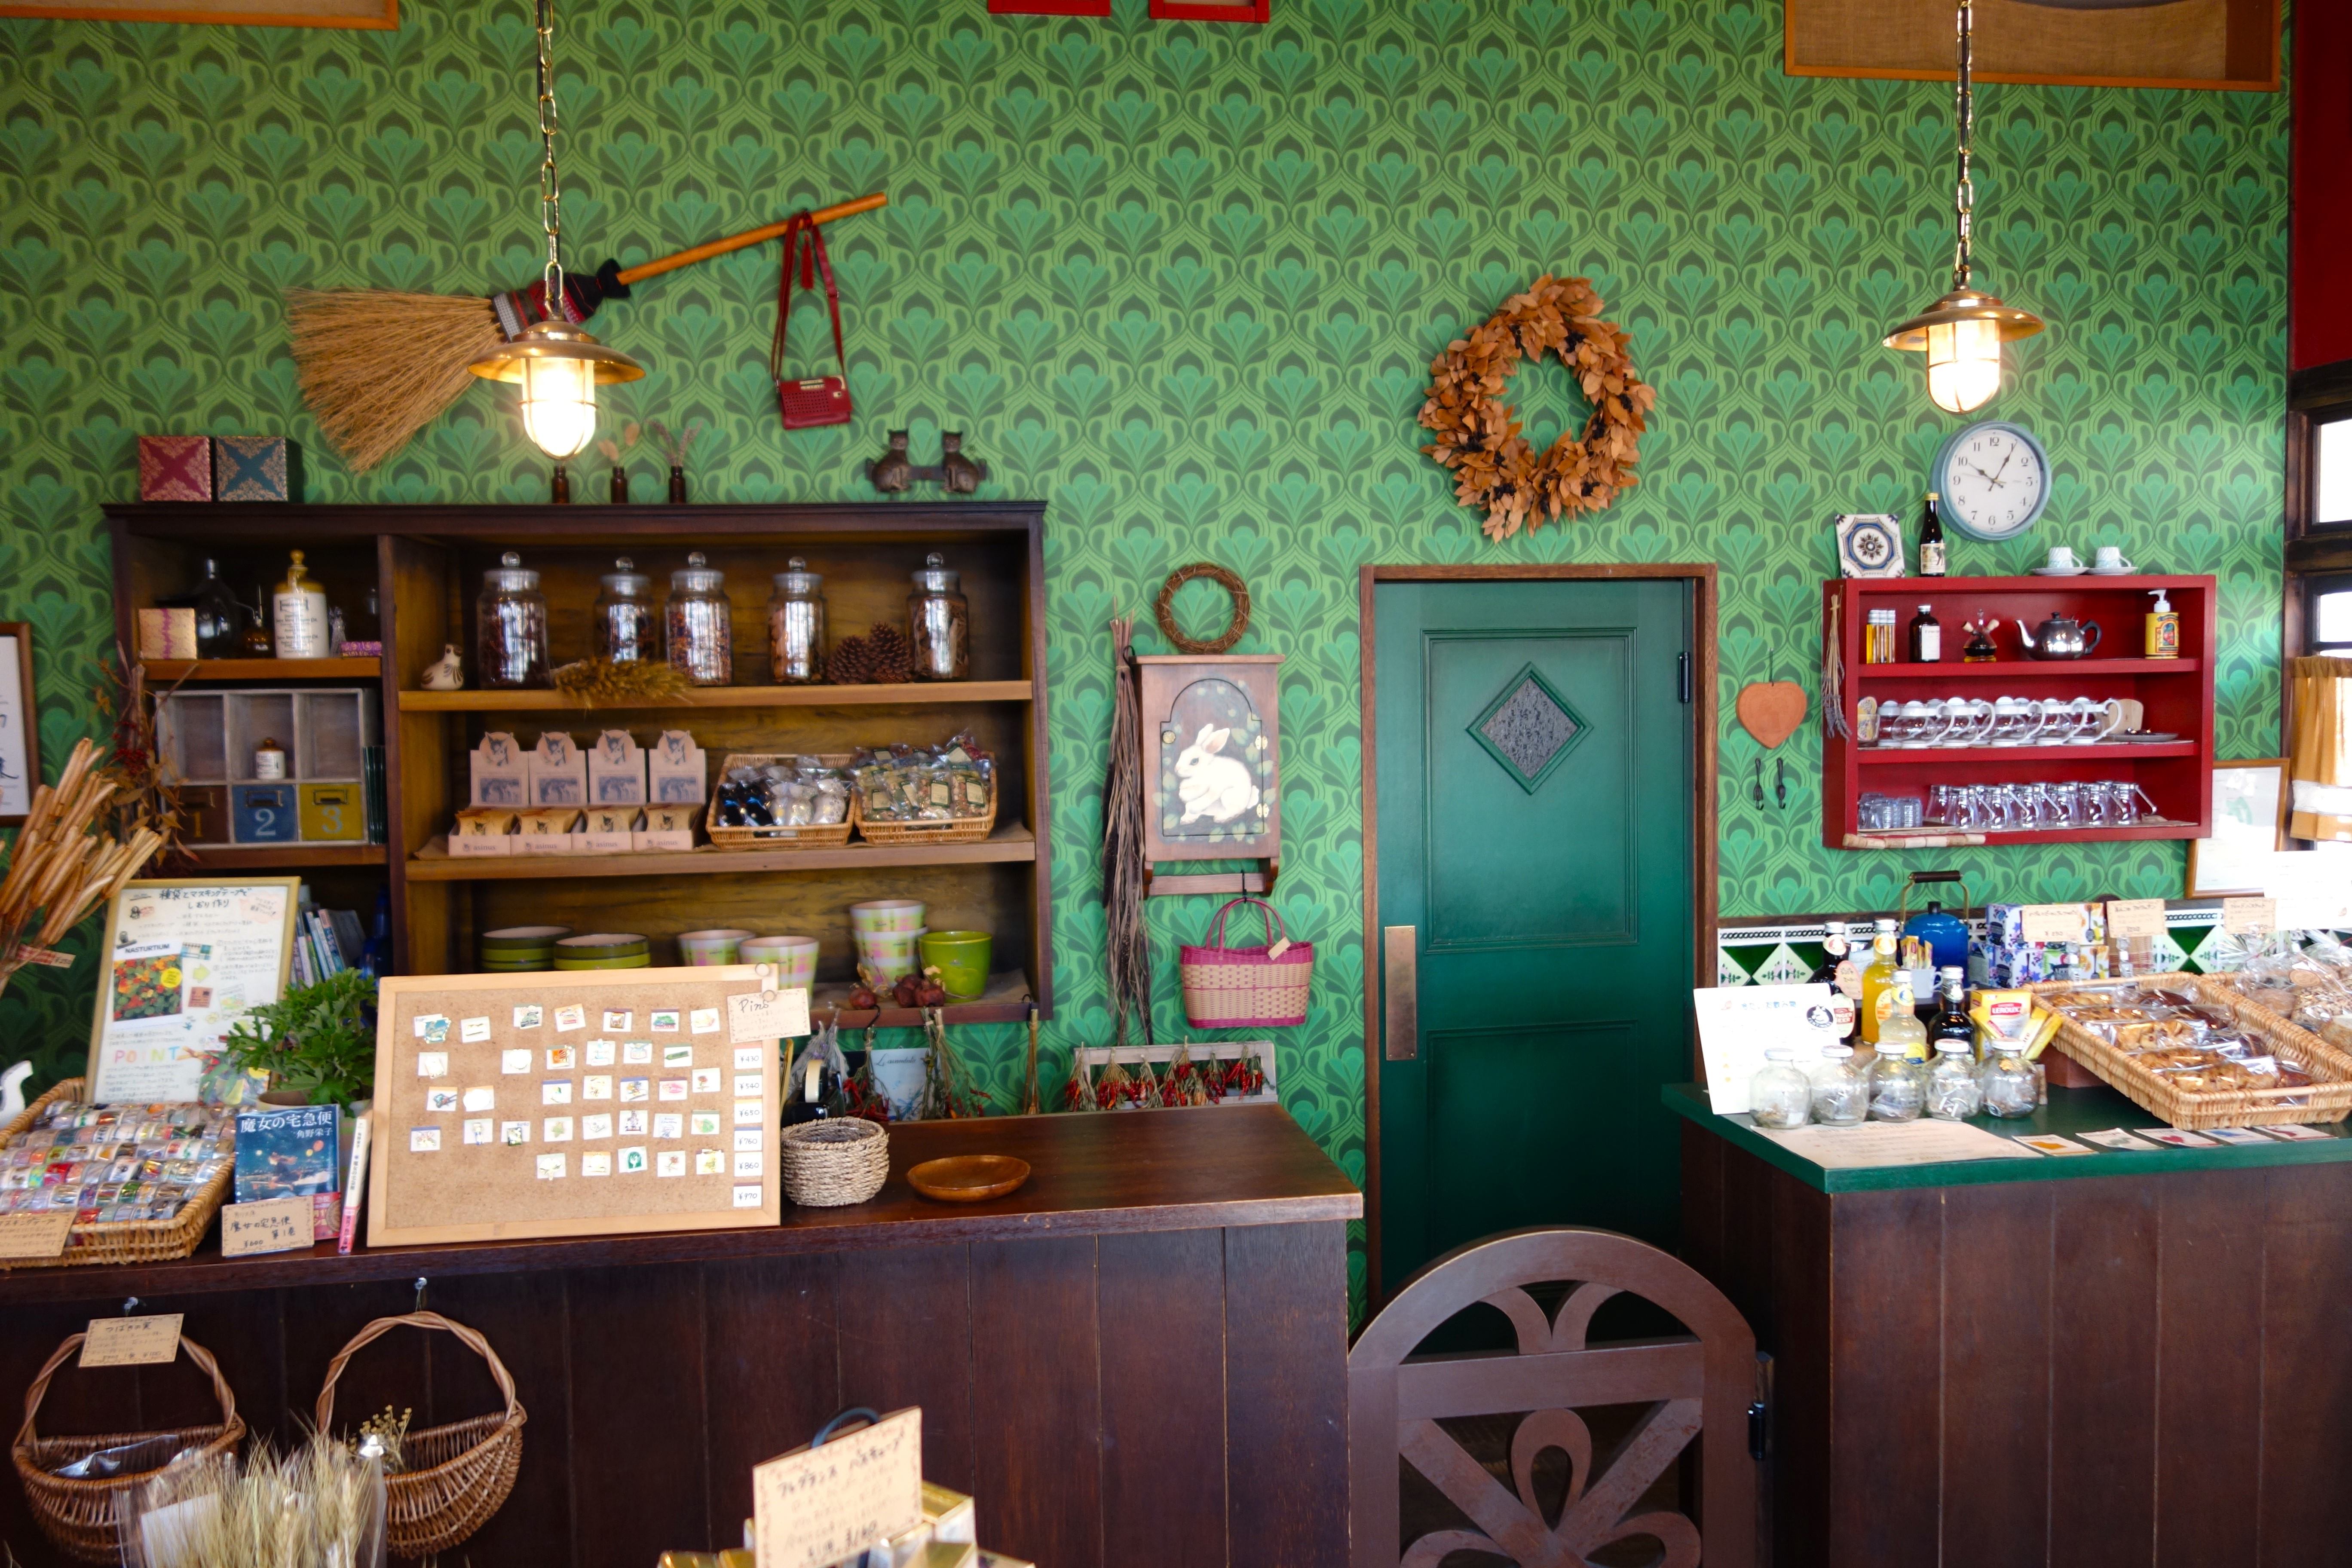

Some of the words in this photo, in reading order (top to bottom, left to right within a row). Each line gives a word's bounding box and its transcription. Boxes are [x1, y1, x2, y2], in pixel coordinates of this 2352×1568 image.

[1989, 437, 1999, 446] 12
[1973, 442, 1980, 451] 11
[1958, 457, 1968, 466] 10
[2021, 457, 2028, 466] 2
[1953, 475, 1960, 485] 9
[2026, 477, 2033, 486] 3
[1958, 495, 1965, 505] 8
[2020, 497, 2028, 506] 4
[1971, 511, 1977, 520] 7
[2007, 510, 2014, 520] 5
[1988, 515, 1995, 525] 6
[255, 808, 276, 836] 2
[322, 805, 343, 834] 3
[190, 811, 203, 838] 1
[125, 943, 170, 953] NASTURTIUM
[738, 998, 769, 1013] Pins
[114, 1046, 180, 1063] POINT
[739, 1082, 760, 1090] ¥540
[739, 1109, 760, 1118] ¥650
[240, 1111, 333, 1133] 魔女の宅急便
[296, 1127, 333, 1139] 角野栄子
[738, 1137, 758, 1145] ¥760
[738, 1162, 759, 1170] ¥860
[738, 1192, 758, 1201] ¥970
[230, 1216, 292, 1232] 魔女の宅急便
[244, 1239, 263, 1248] ¥600
